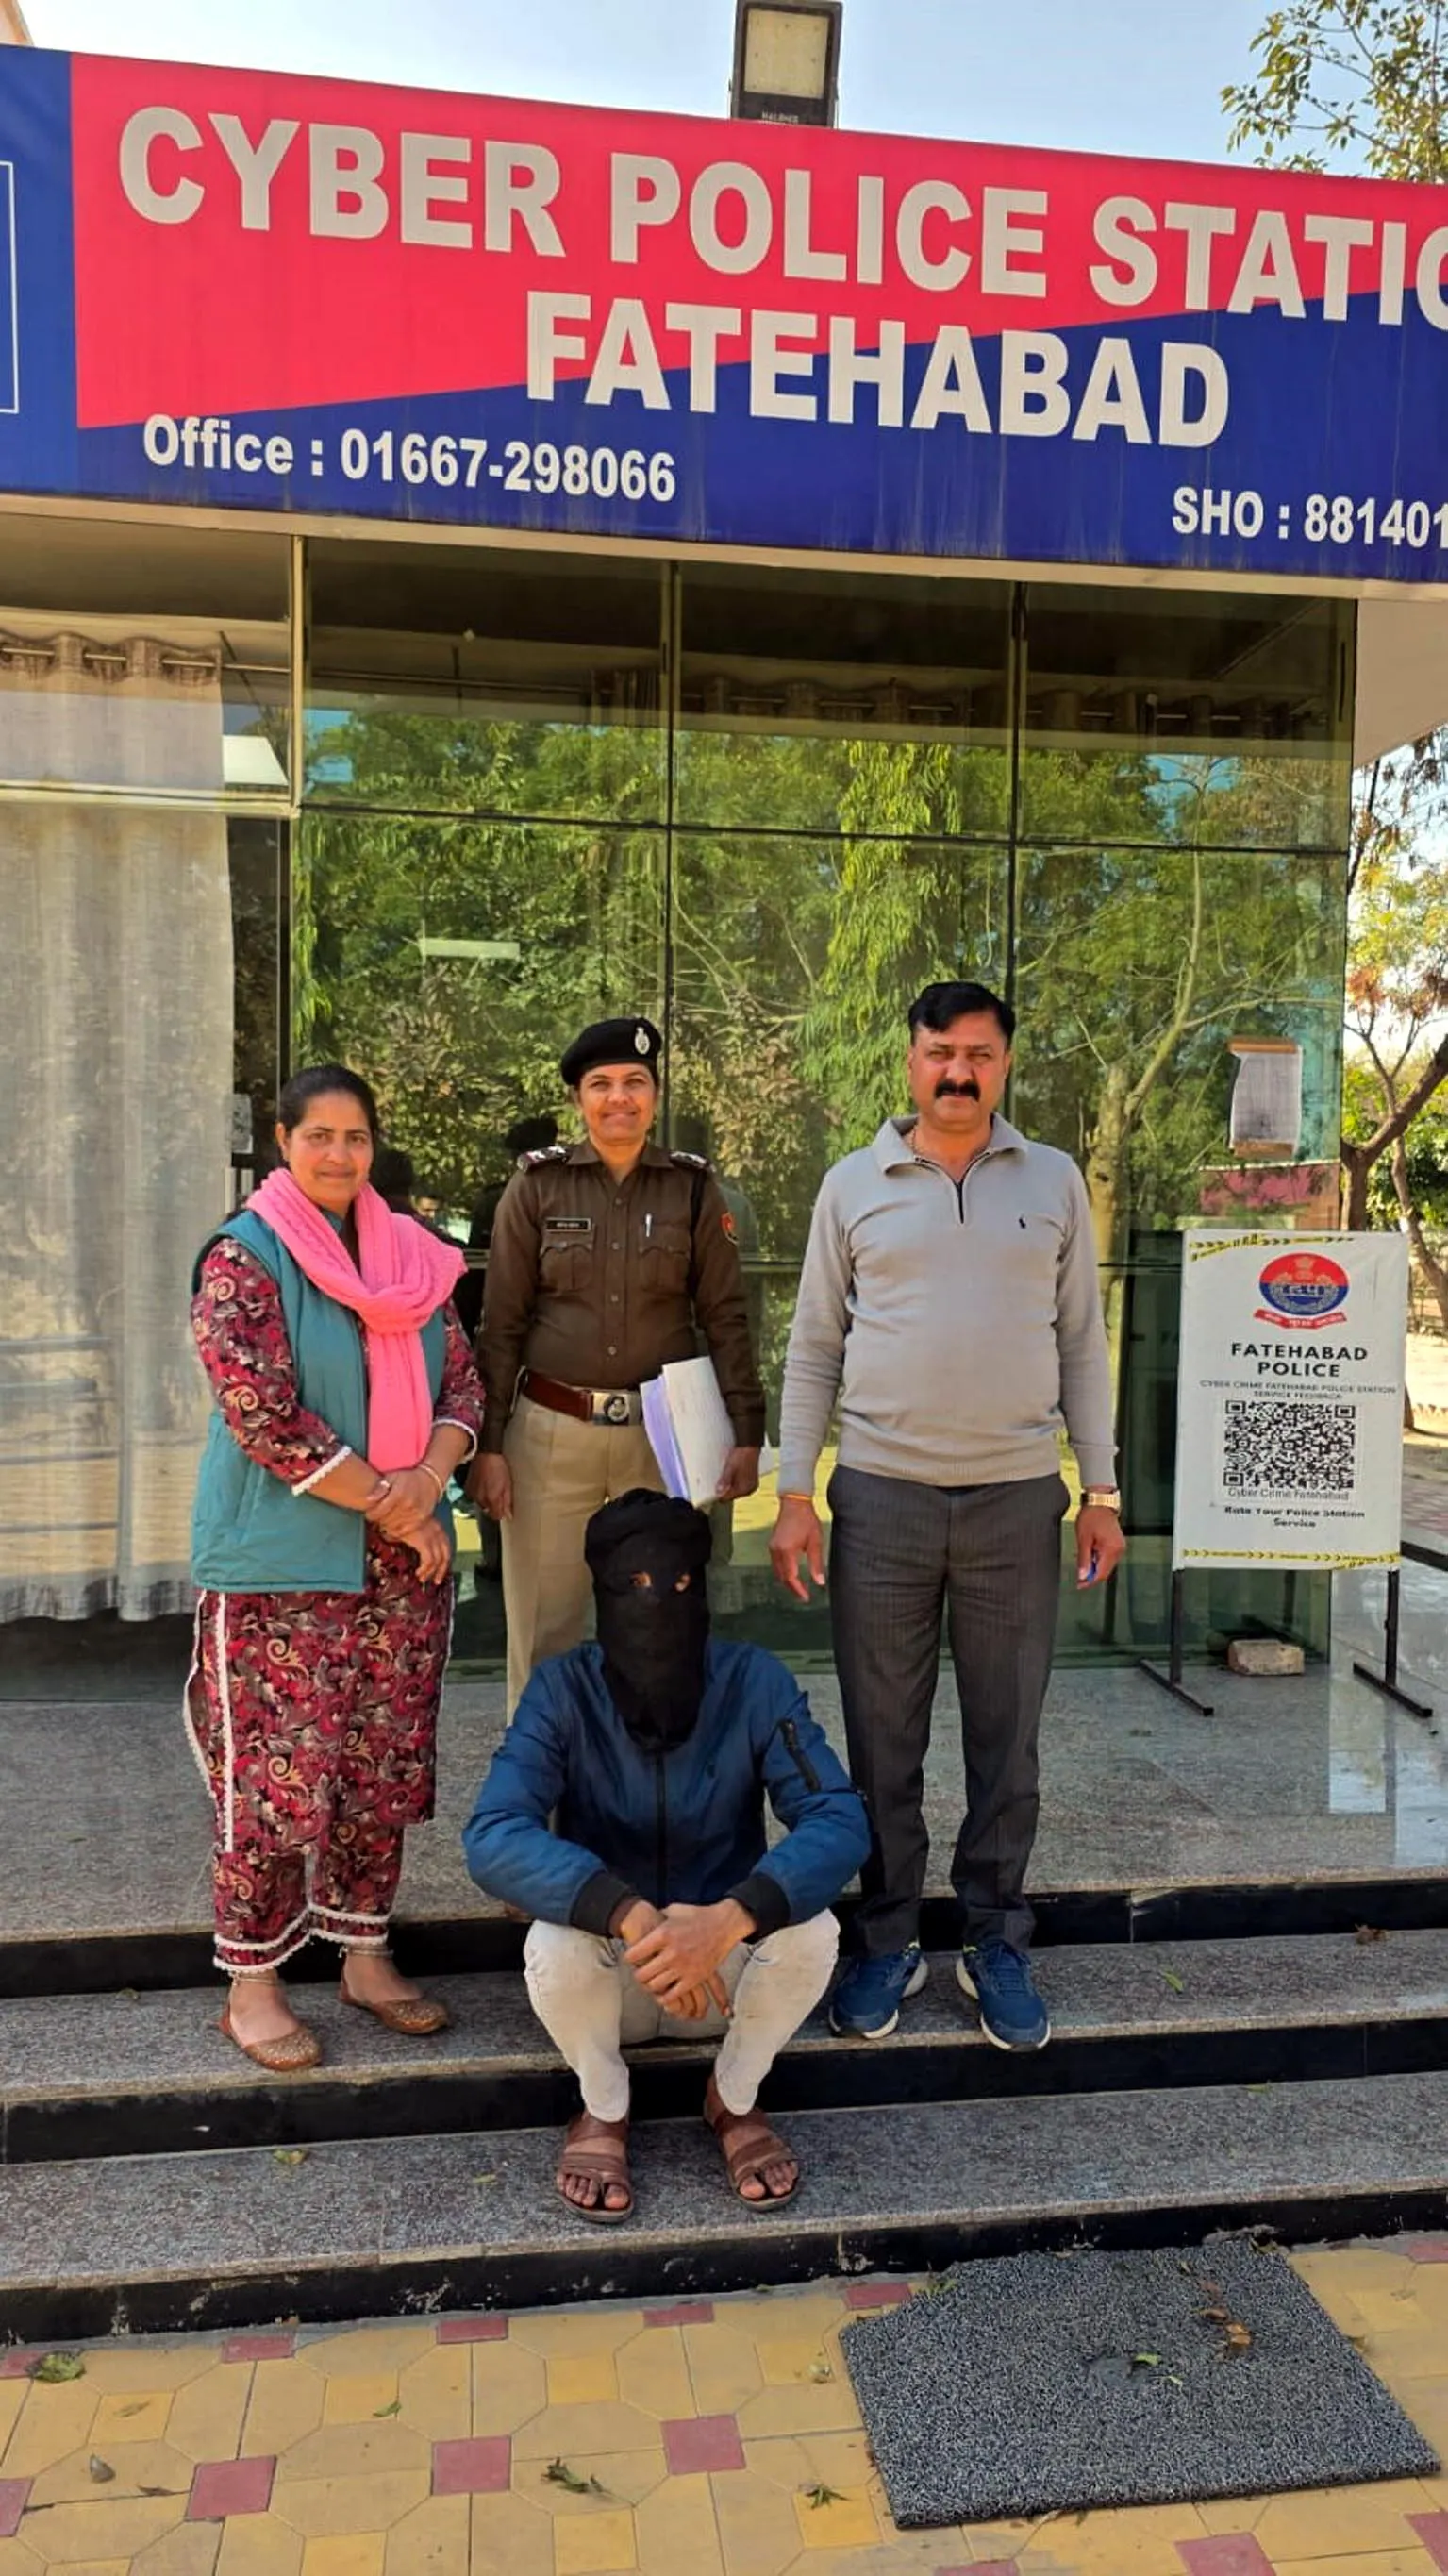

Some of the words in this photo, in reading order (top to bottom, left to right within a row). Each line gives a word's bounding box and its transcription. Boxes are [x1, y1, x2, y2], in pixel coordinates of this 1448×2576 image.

[119, 106, 566, 258] CYBER
[610, 152, 1048, 298] POLICE
[526, 290, 1229, 448] FATEHABAD
[143, 413, 293, 475] Office
[311, 441, 323, 476] :
[341, 428, 675, 503] 01667-298066
[1173, 486, 1264, 538] SHO
[1278, 503, 1289, 539] :
[1304, 493, 1448, 549] 881401
[1231, 1342, 1368, 1361] FATEHABAD
[1257, 1361, 1340, 1378] POLICE
[1228, 1488, 1257, 1498] Cyber
[1260, 1488, 1291, 1498] Crime
[1293, 1490, 1349, 1500] Fatehabad
[1224, 1506, 1251, 1514] Rate
[1256, 1507, 1282, 1515] Your
[1286, 1508, 1320, 1516] Police
[1323, 1510, 1365, 1518] Station
[1273, 1517, 1316, 1528] Service
